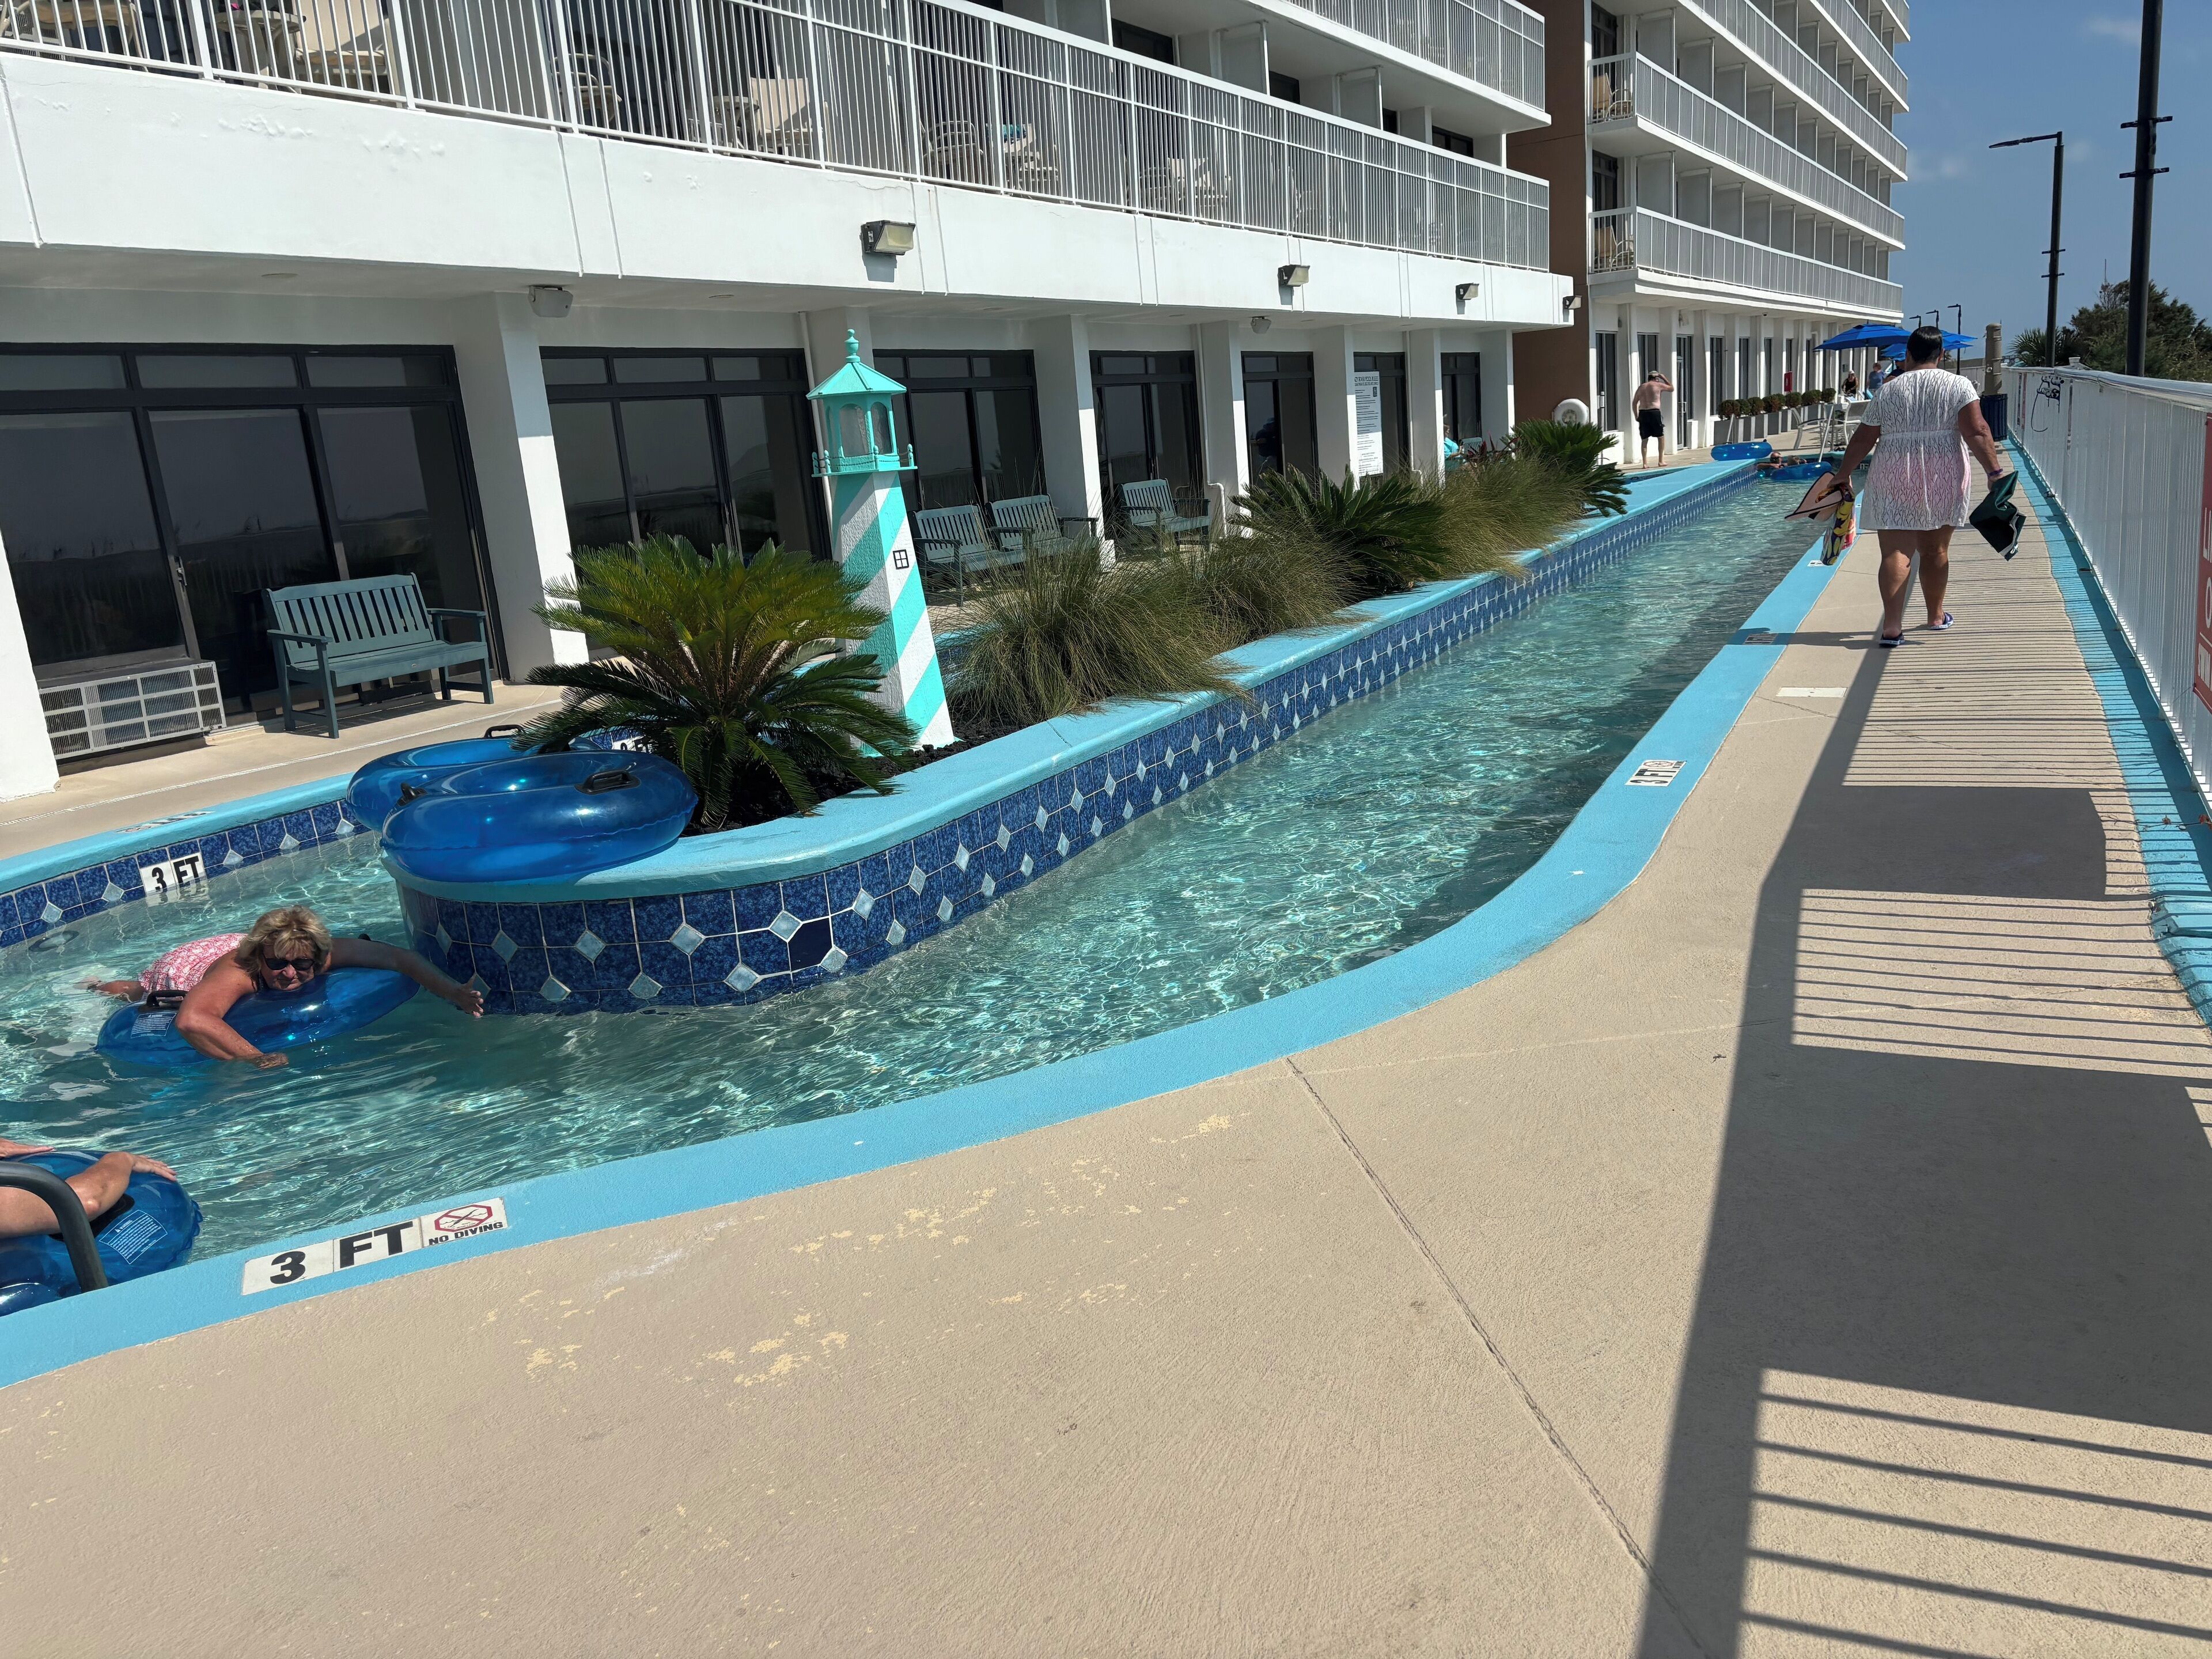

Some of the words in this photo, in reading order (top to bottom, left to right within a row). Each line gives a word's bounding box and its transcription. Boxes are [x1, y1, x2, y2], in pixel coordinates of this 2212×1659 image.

[2203, 507, 2212, 563] LI
[1634, 768, 1677, 777] FT
[151, 867, 167, 891] 3
[173, 855, 199, 884] FT
[428, 1235, 449, 1245] NO
[454, 1222, 503, 1239] DIVING
[270, 1251, 306, 1285] 3
[339, 1221, 413, 1268] FT
